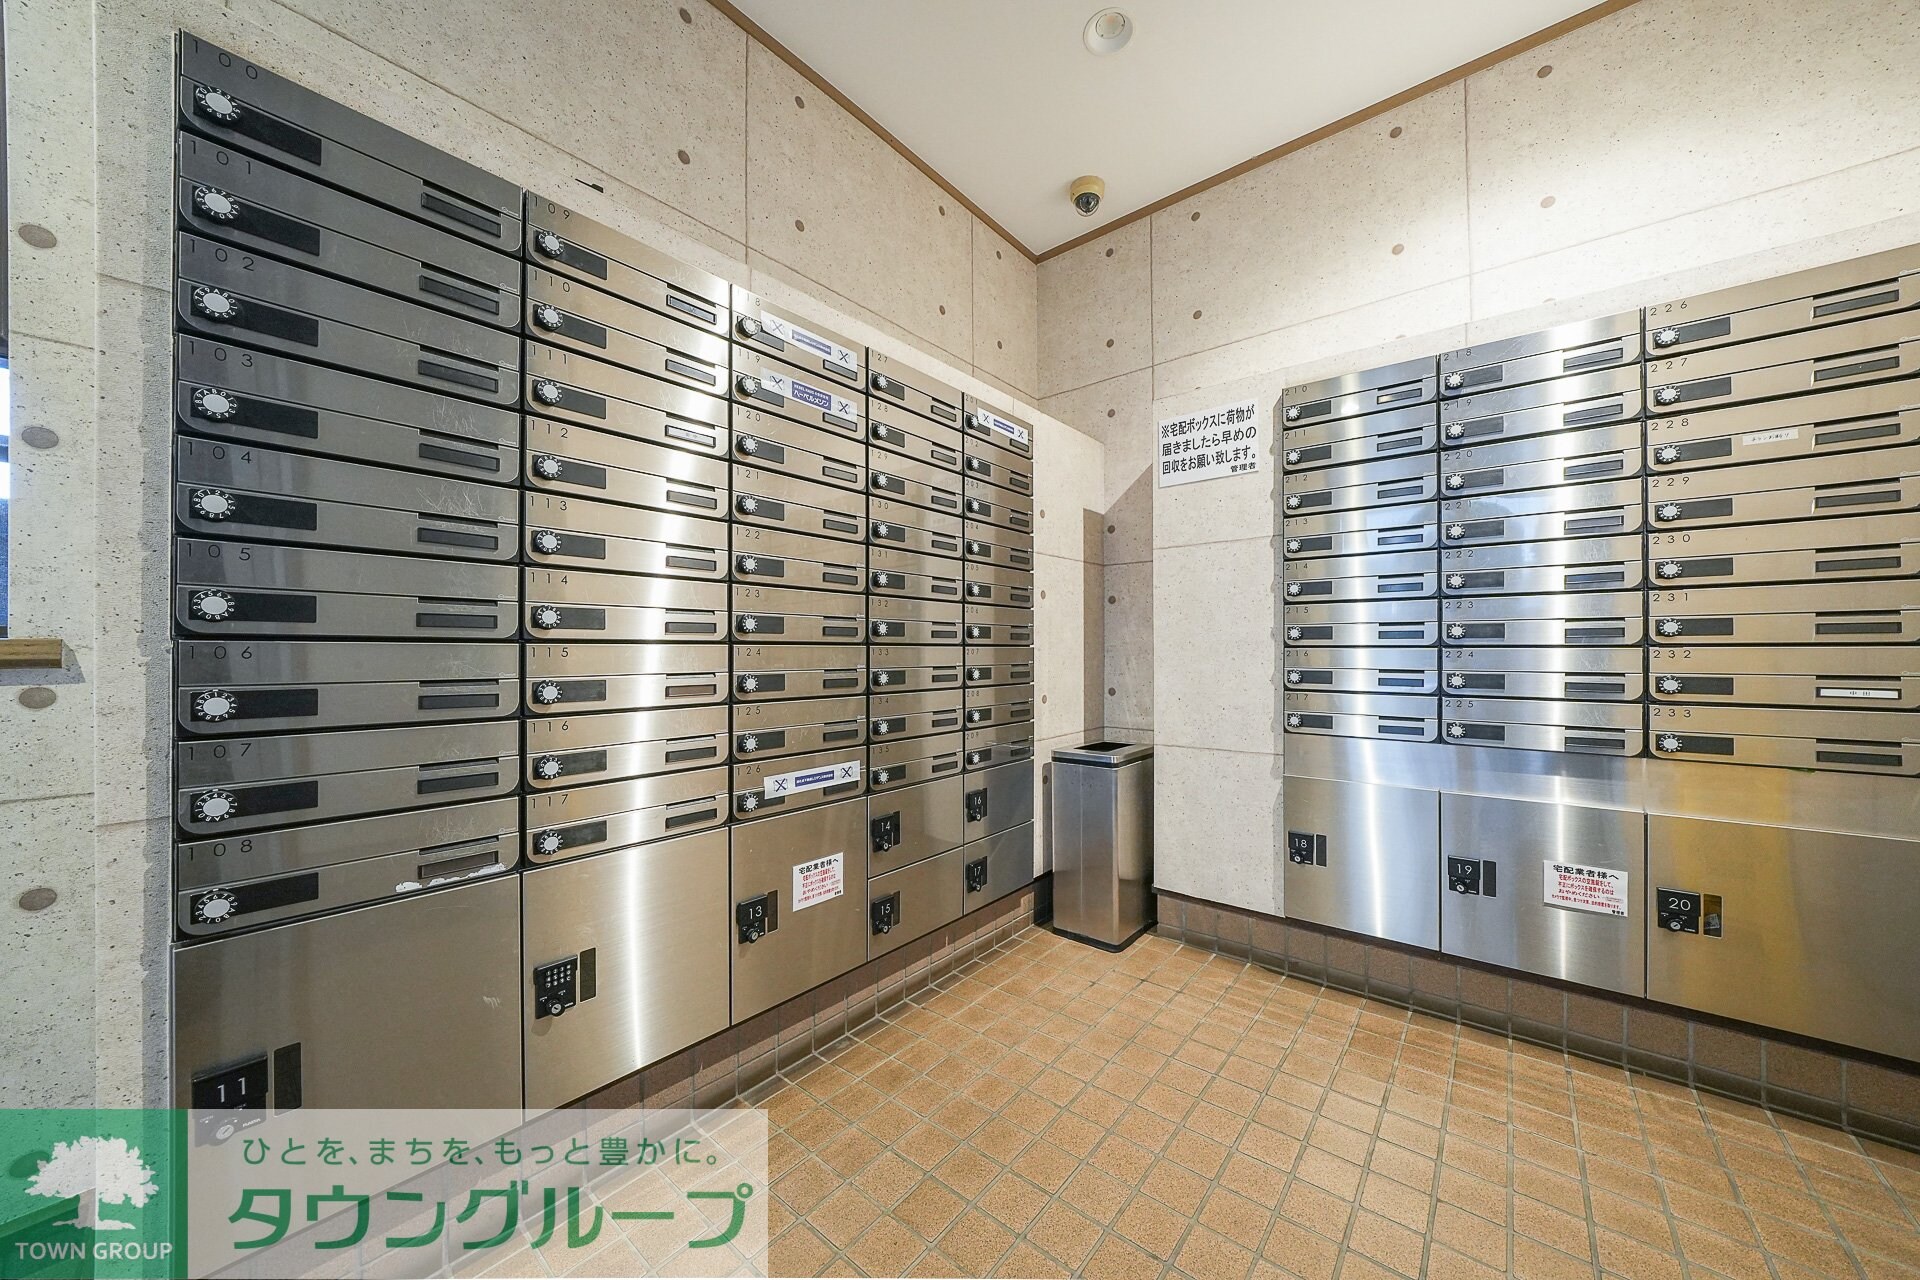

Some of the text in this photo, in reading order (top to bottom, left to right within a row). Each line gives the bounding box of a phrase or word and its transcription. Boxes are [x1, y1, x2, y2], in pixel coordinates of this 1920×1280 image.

[192, 39, 259, 81] 100
[189, 139, 253, 175] 101
[533, 195, 571, 220] 109
[188, 238, 256, 272] 102
[533, 270, 571, 293] 110
[1650, 300, 1688, 316] 226
[187, 339, 254, 368] 103
[532, 344, 568, 365] 111
[738, 348, 761, 363] 119
[871, 350, 889, 363] 127
[1444, 349, 1472, 361] 218
[1650, 358, 1688, 373] 227
[1285, 385, 1308, 396] 210
[966, 394, 978, 405] 201
[1444, 398, 1472, 410] 219
[736, 407, 761, 422] 120
[1161, 404, 1255, 439] ※宅配ボックスに荷物が
[1651, 418, 1689, 431] 228
[531, 419, 568, 439] 112
[1285, 430, 1308, 439] 211
[966, 437, 979, 447] 202
[1161, 425, 1257, 457] 届きましたら早めの
[186, 441, 253, 465] 104
[1444, 450, 1473, 462] 220
[1161, 445, 1257, 475] 回収をお願い致します。
[736, 467, 759, 480] 121
[1230, 462, 1257, 473] 管理者
[1285, 474, 1308, 484] 212
[1652, 476, 1690, 488] 229
[530, 495, 568, 511] 113
[871, 498, 889, 510] 130
[1444, 500, 1473, 510] 221
[1285, 517, 1308, 527] 213
[735, 527, 760, 540] 122
[1652, 534, 1690, 545] 230
[186, 541, 251, 561] 105
[871, 548, 889, 559] 131
[1444, 550, 1473, 560] 222
[1285, 562, 1308, 570] 214
[531, 571, 568, 585] 114
[735, 587, 760, 599] 123
[1652, 593, 1690, 602] 231
[871, 598, 889, 608] 132
[1444, 600, 1473, 609] 223
[1285, 606, 1308, 614] 215
[189, 644, 253, 660] 106
[531, 646, 569, 658] 115
[736, 647, 761, 657] 124
[871, 648, 889, 657] 133
[1285, 650, 1308, 658] 216
[1444, 650, 1473, 659] 224
[1653, 650, 1691, 659] 232
[871, 696, 889, 705] 134
[1285, 693, 1308, 701] 217
[1444, 699, 1473, 708] 225
[736, 706, 761, 716] 125
[1653, 708, 1691, 718] 233
[531, 720, 569, 734] 116
[188, 742, 252, 761] 107
[871, 745, 889, 755] 135
[737, 765, 761, 776] 126
[531, 793, 569, 809] 117
[974, 796, 982, 805] 16
[880, 820, 891, 832] 14
[1294, 838, 1308, 848] 18
[188, 838, 253, 861] 108
[974, 866, 982, 876] 17
[1457, 863, 1472, 874] 19
[1552, 864, 1619, 880] 宅配業者様へ
[880, 903, 891, 915] 15
[1668, 897, 1691, 911] 20
[749, 905, 762, 919] 13
[217, 1077, 246, 1103] 11
